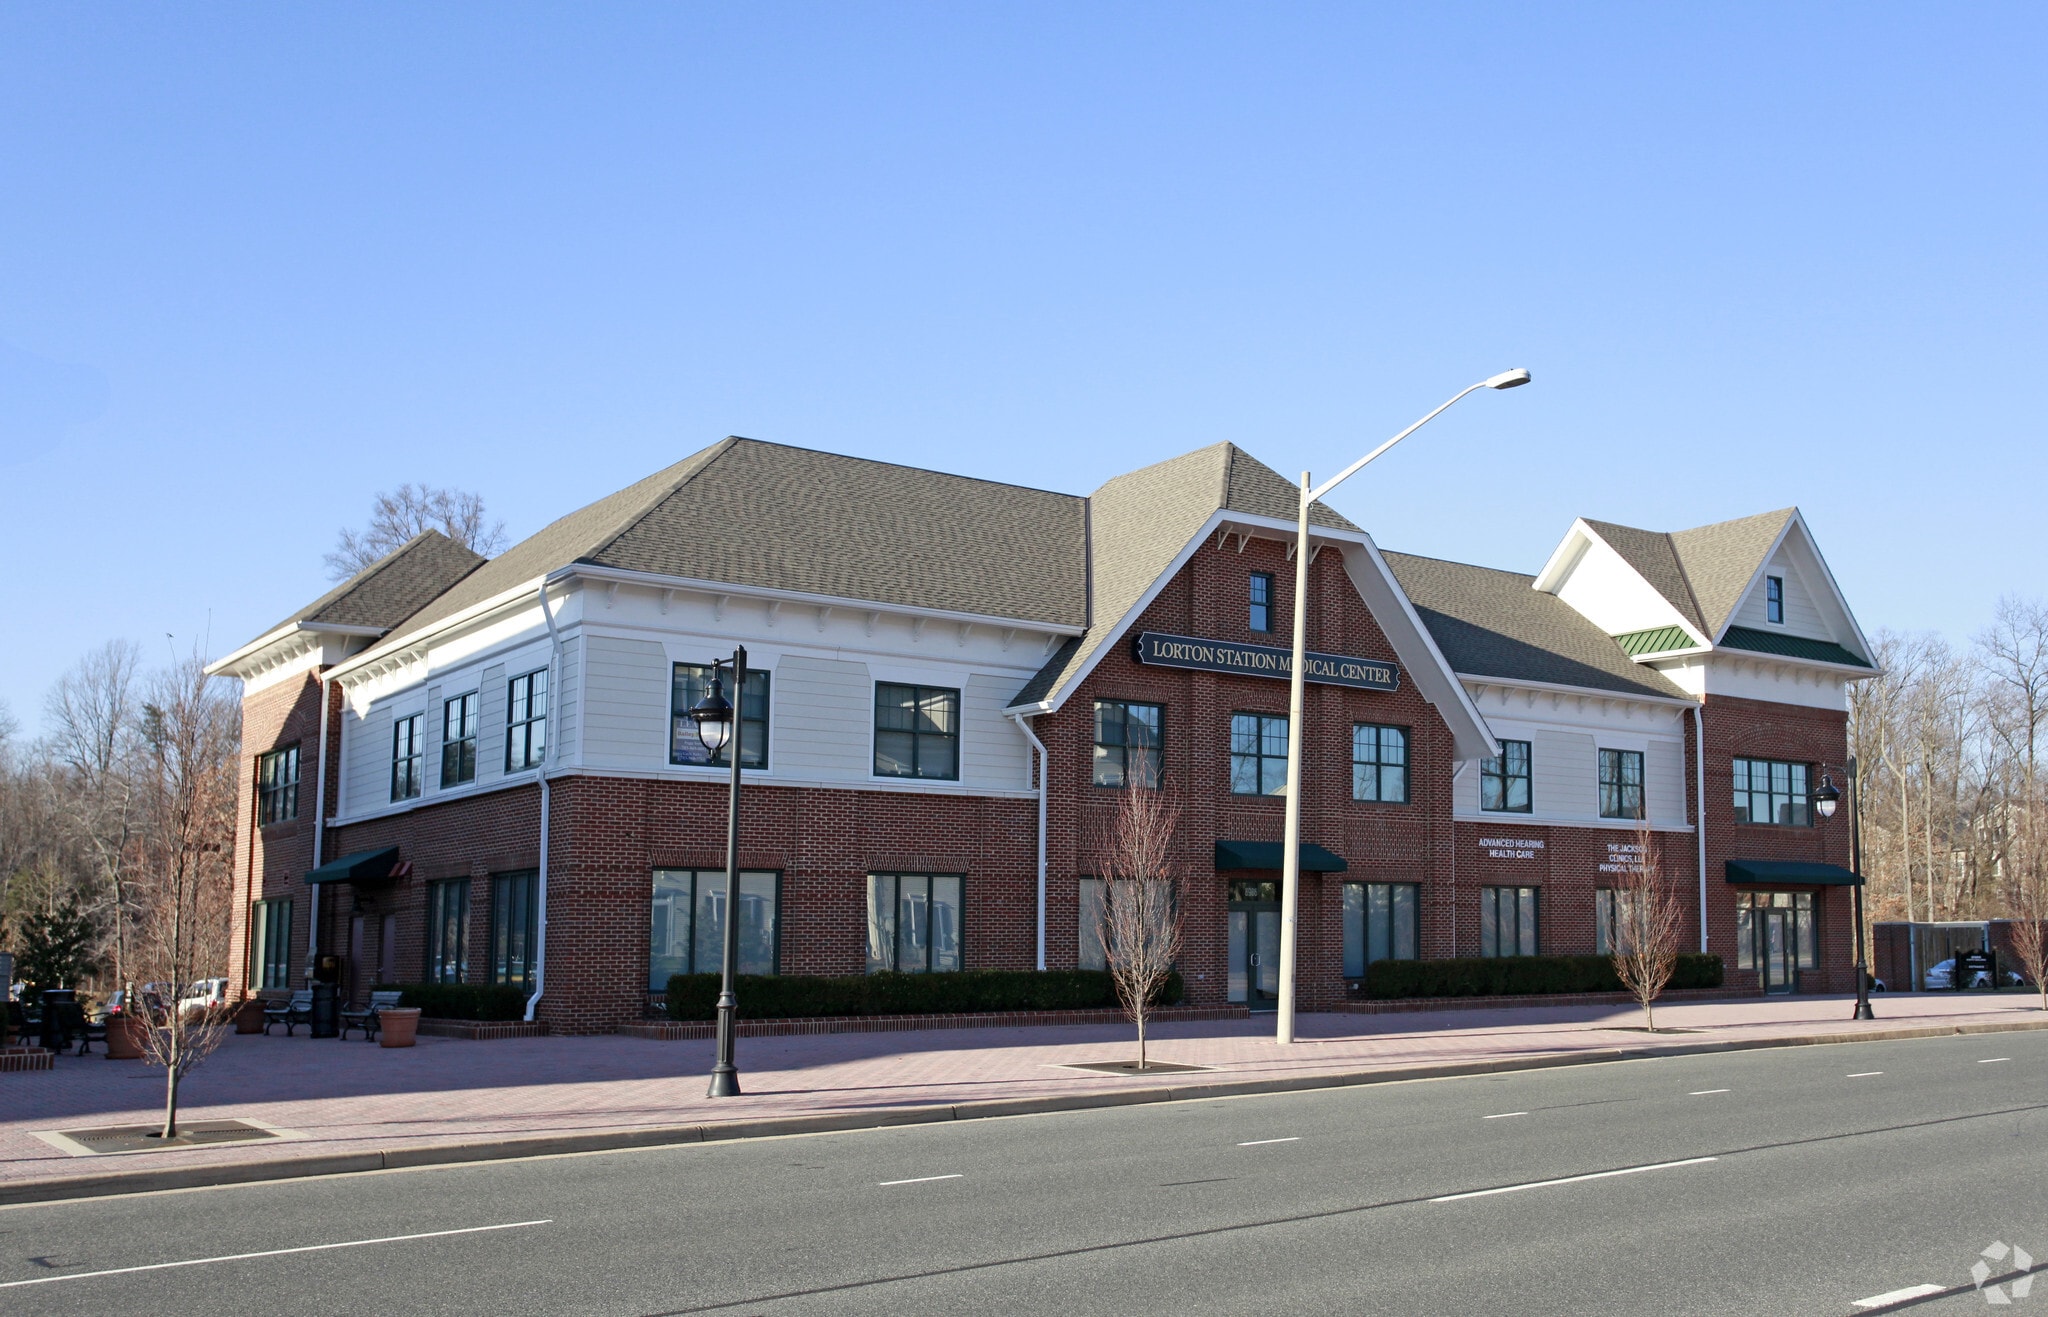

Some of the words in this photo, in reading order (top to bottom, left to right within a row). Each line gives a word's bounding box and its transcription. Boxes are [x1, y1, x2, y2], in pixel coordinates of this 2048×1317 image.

[1153, 640, 1214, 663] LORTON
[1217, 648, 1276, 670] STATION
[1279, 655, 1339, 677] MDICAL
[1341, 663, 1391, 683] CENTER
[1479, 838, 1514, 848] ADVANCED
[1515, 839, 1545, 849] HEARING
[1607, 844, 1619, 852] THE
[1489, 849, 1515, 858] HEALTH
[1516, 850, 1535, 859] CARE
[1634, 855, 1645, 863] LL
[1599, 864, 1628, 872] PHYSICAL
[1629, 864, 1656, 873] THERY
